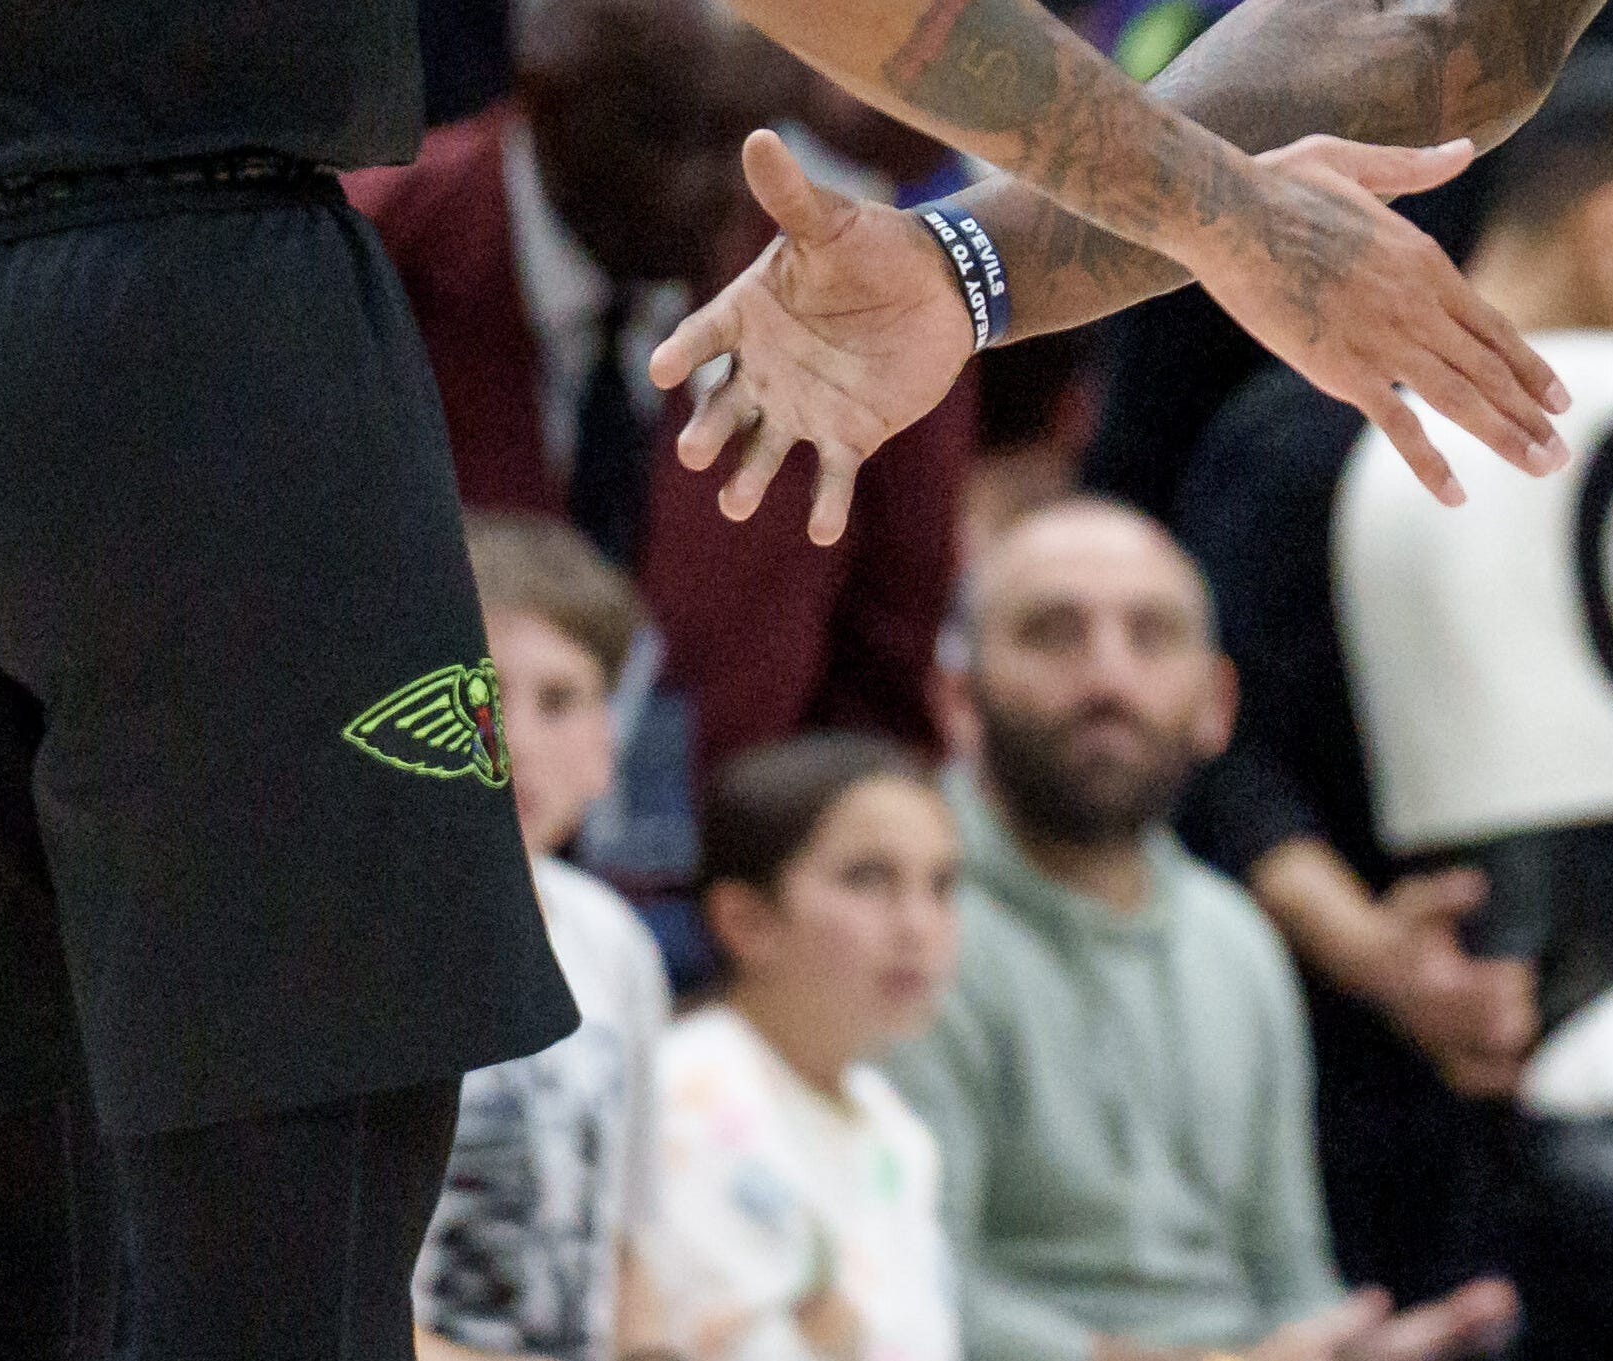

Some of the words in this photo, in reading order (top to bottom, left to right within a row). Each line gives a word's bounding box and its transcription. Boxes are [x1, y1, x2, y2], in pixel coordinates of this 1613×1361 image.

[924, 211, 957, 242] DIE
[952, 244, 974, 275] TO
[959, 217, 1005, 297] D'EVILS
